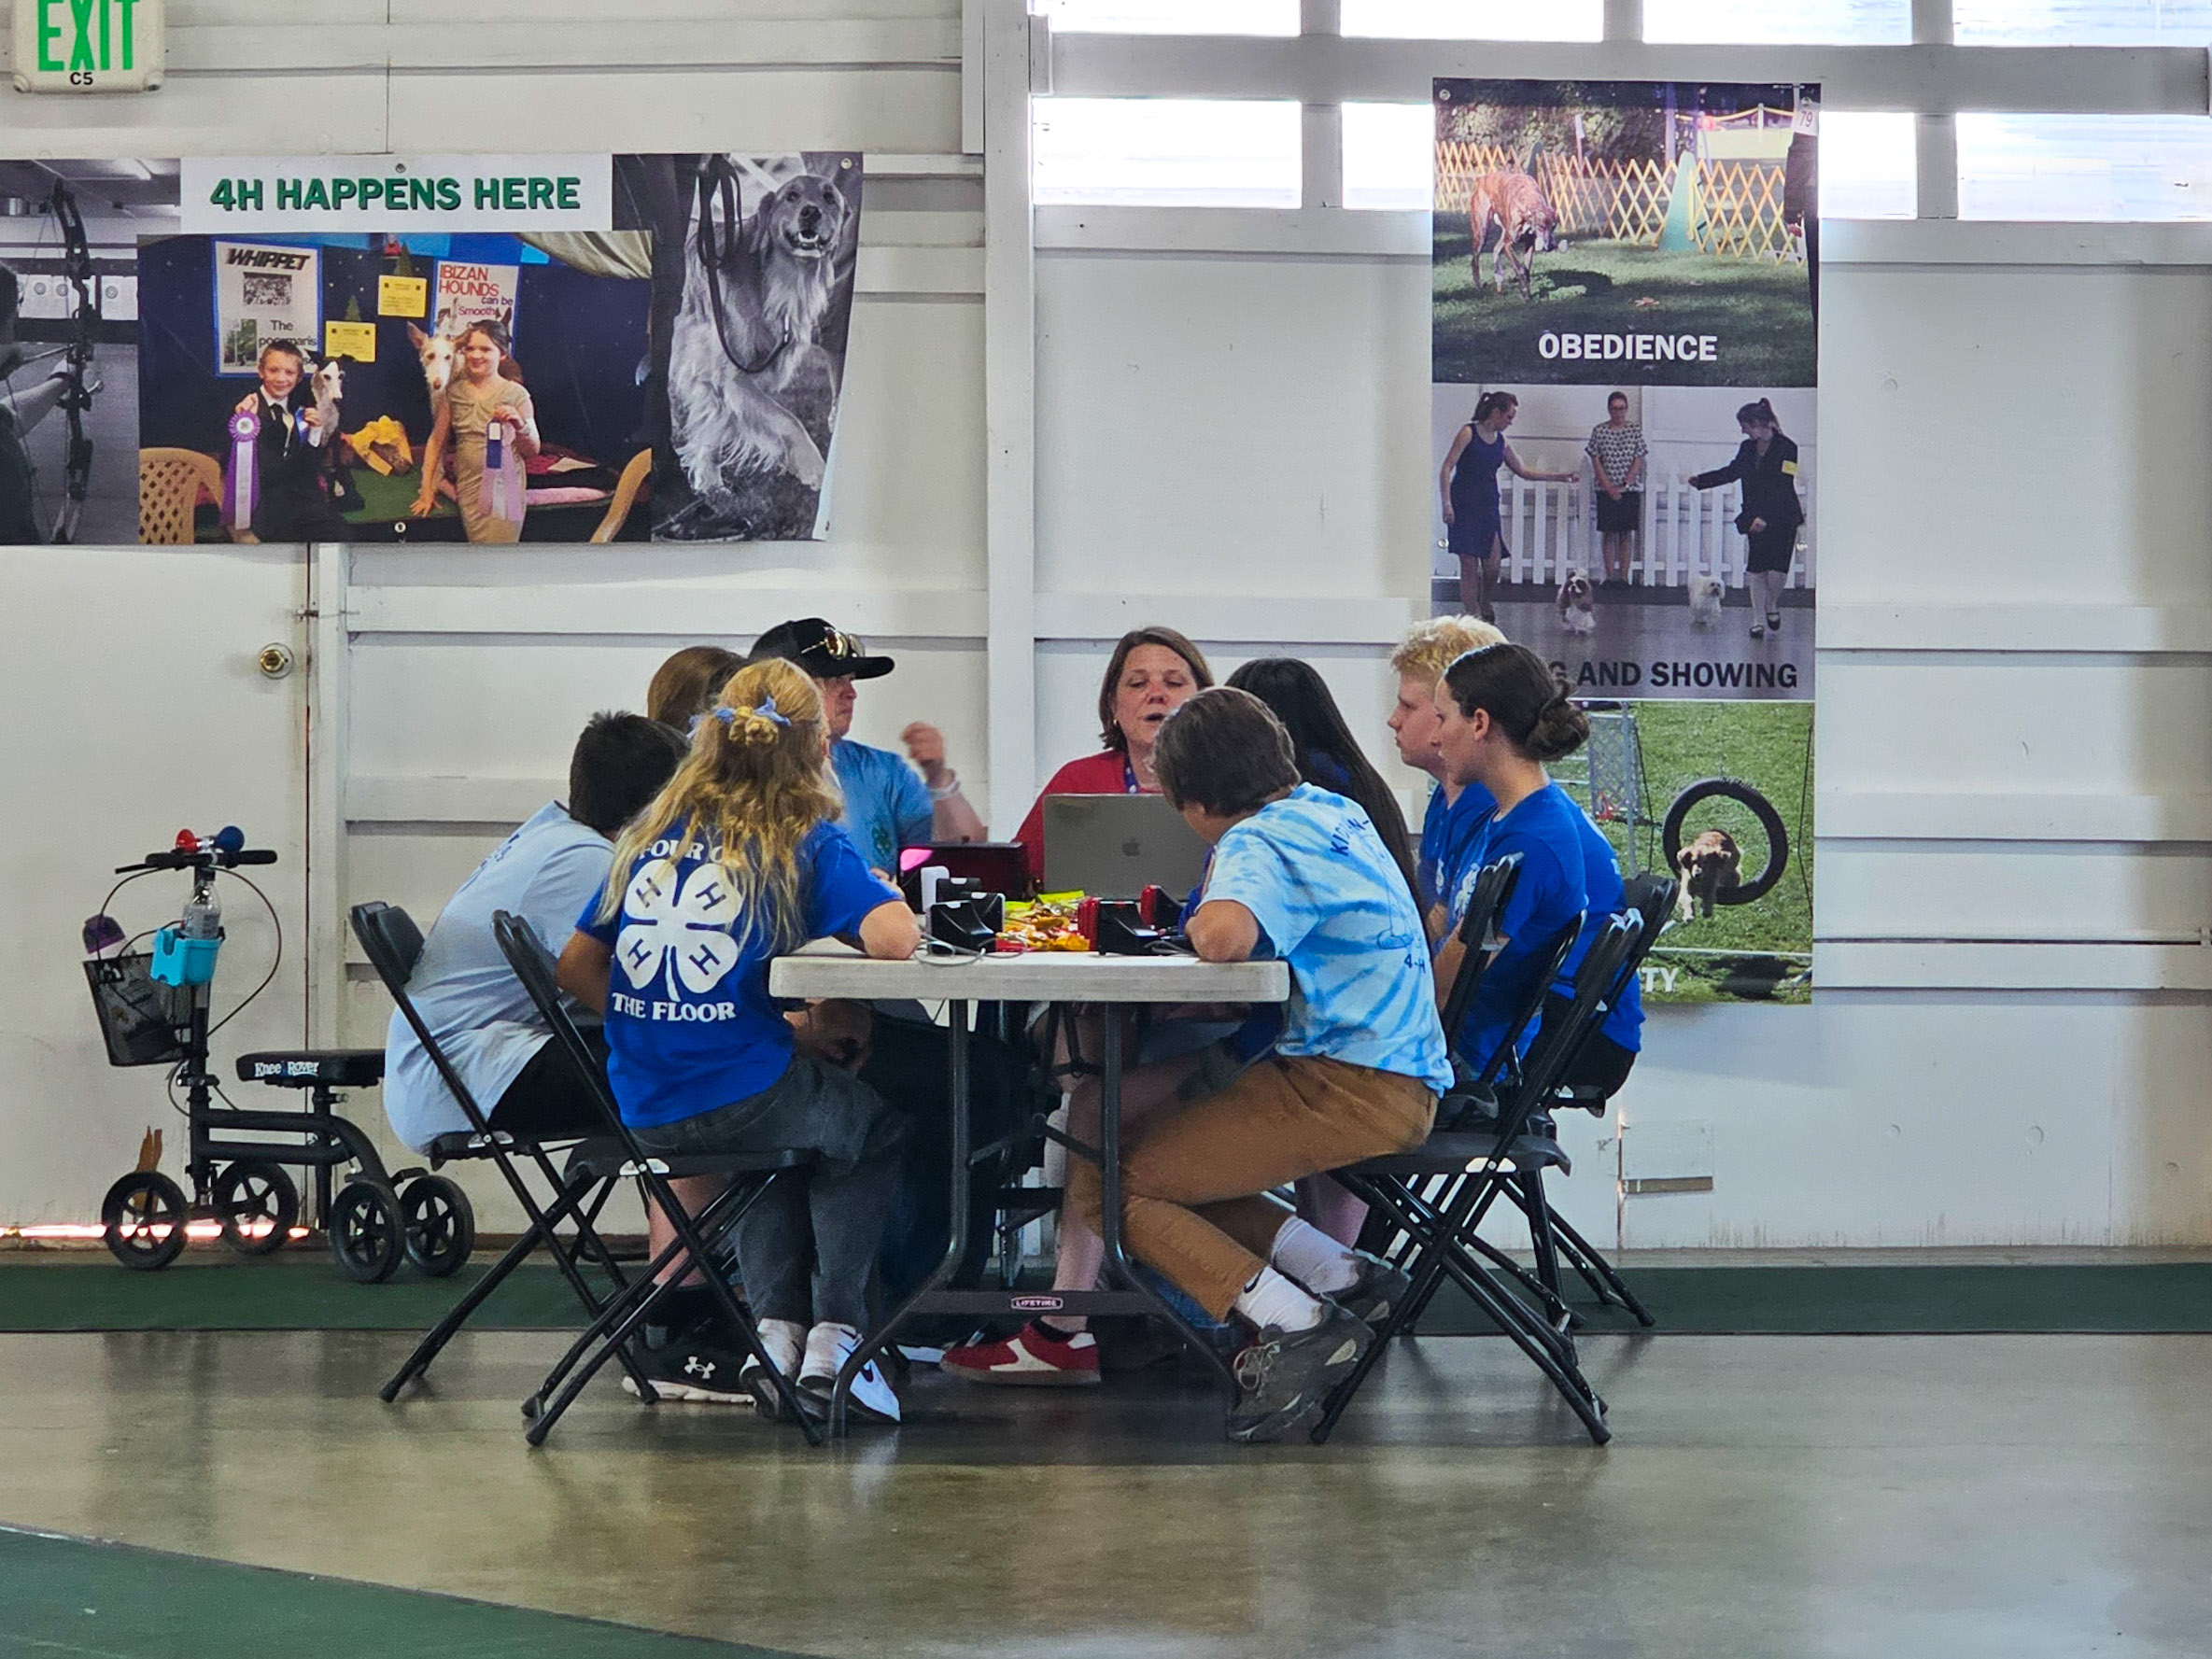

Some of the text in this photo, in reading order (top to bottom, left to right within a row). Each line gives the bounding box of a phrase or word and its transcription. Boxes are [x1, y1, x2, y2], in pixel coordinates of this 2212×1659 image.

[37, 0, 140, 71] EXIT
[69, 72, 93, 85] C5
[1799, 110, 1813, 127] 79
[209, 176, 581, 211] 4H HAPPENS HERE
[226, 248, 311, 271] WHIPPET
[440, 264, 488, 281] IBIZAN
[439, 280, 500, 297] HOUNDS
[481, 296, 514, 306] can be
[270, 319, 294, 330] The
[1538, 332, 1718, 361] OBEDIENCE
[1577, 661, 1641, 687] AND
[1650, 661, 1797, 689] SHOWING
[612, 991, 736, 1022] THE FLOOR
[254, 1061, 319, 1077] Knee Rover
